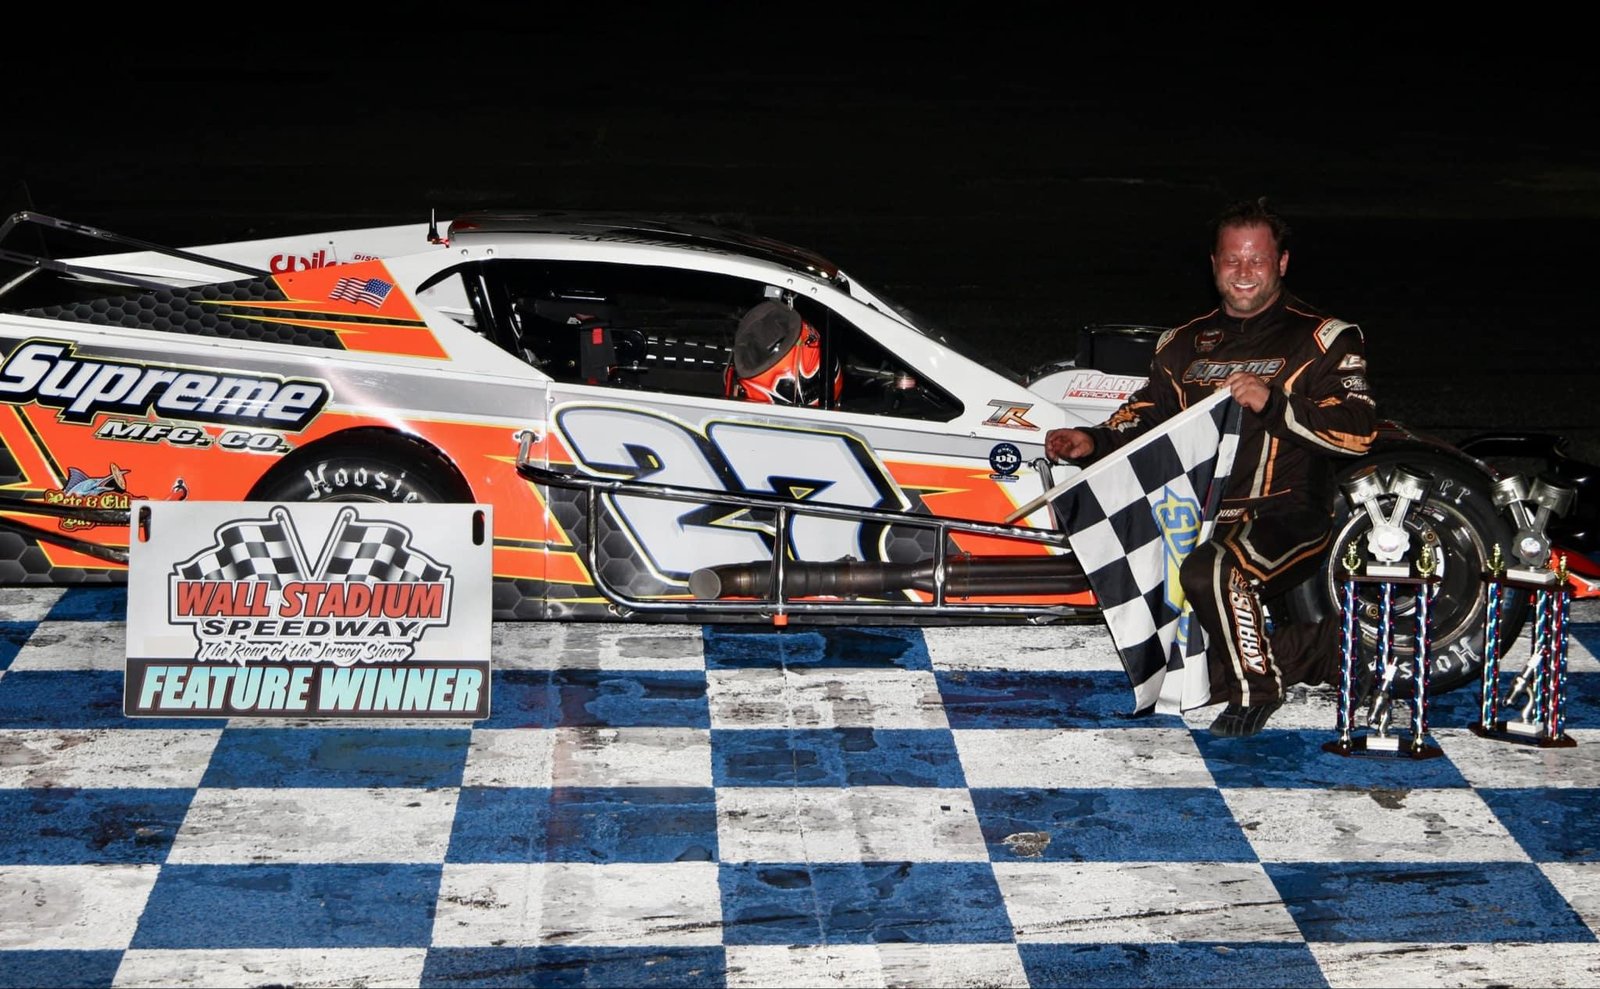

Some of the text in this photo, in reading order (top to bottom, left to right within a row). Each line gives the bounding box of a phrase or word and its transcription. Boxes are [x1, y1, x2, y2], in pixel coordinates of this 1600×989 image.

[0, 340, 326, 426] Supreme
[98, 421, 293, 453] MFG. CO.
[48, 492, 82, 506] Pete
[86, 496, 98, 508] &
[552, 404, 898, 585] 27
[177, 581, 445, 618] WALL STADIUM
[202, 619, 419, 637] SPEEDWAY
[202, 642, 406, 662] The Roar of the Jersey Shore
[138, 665, 483, 713] FEATURE WINNER
